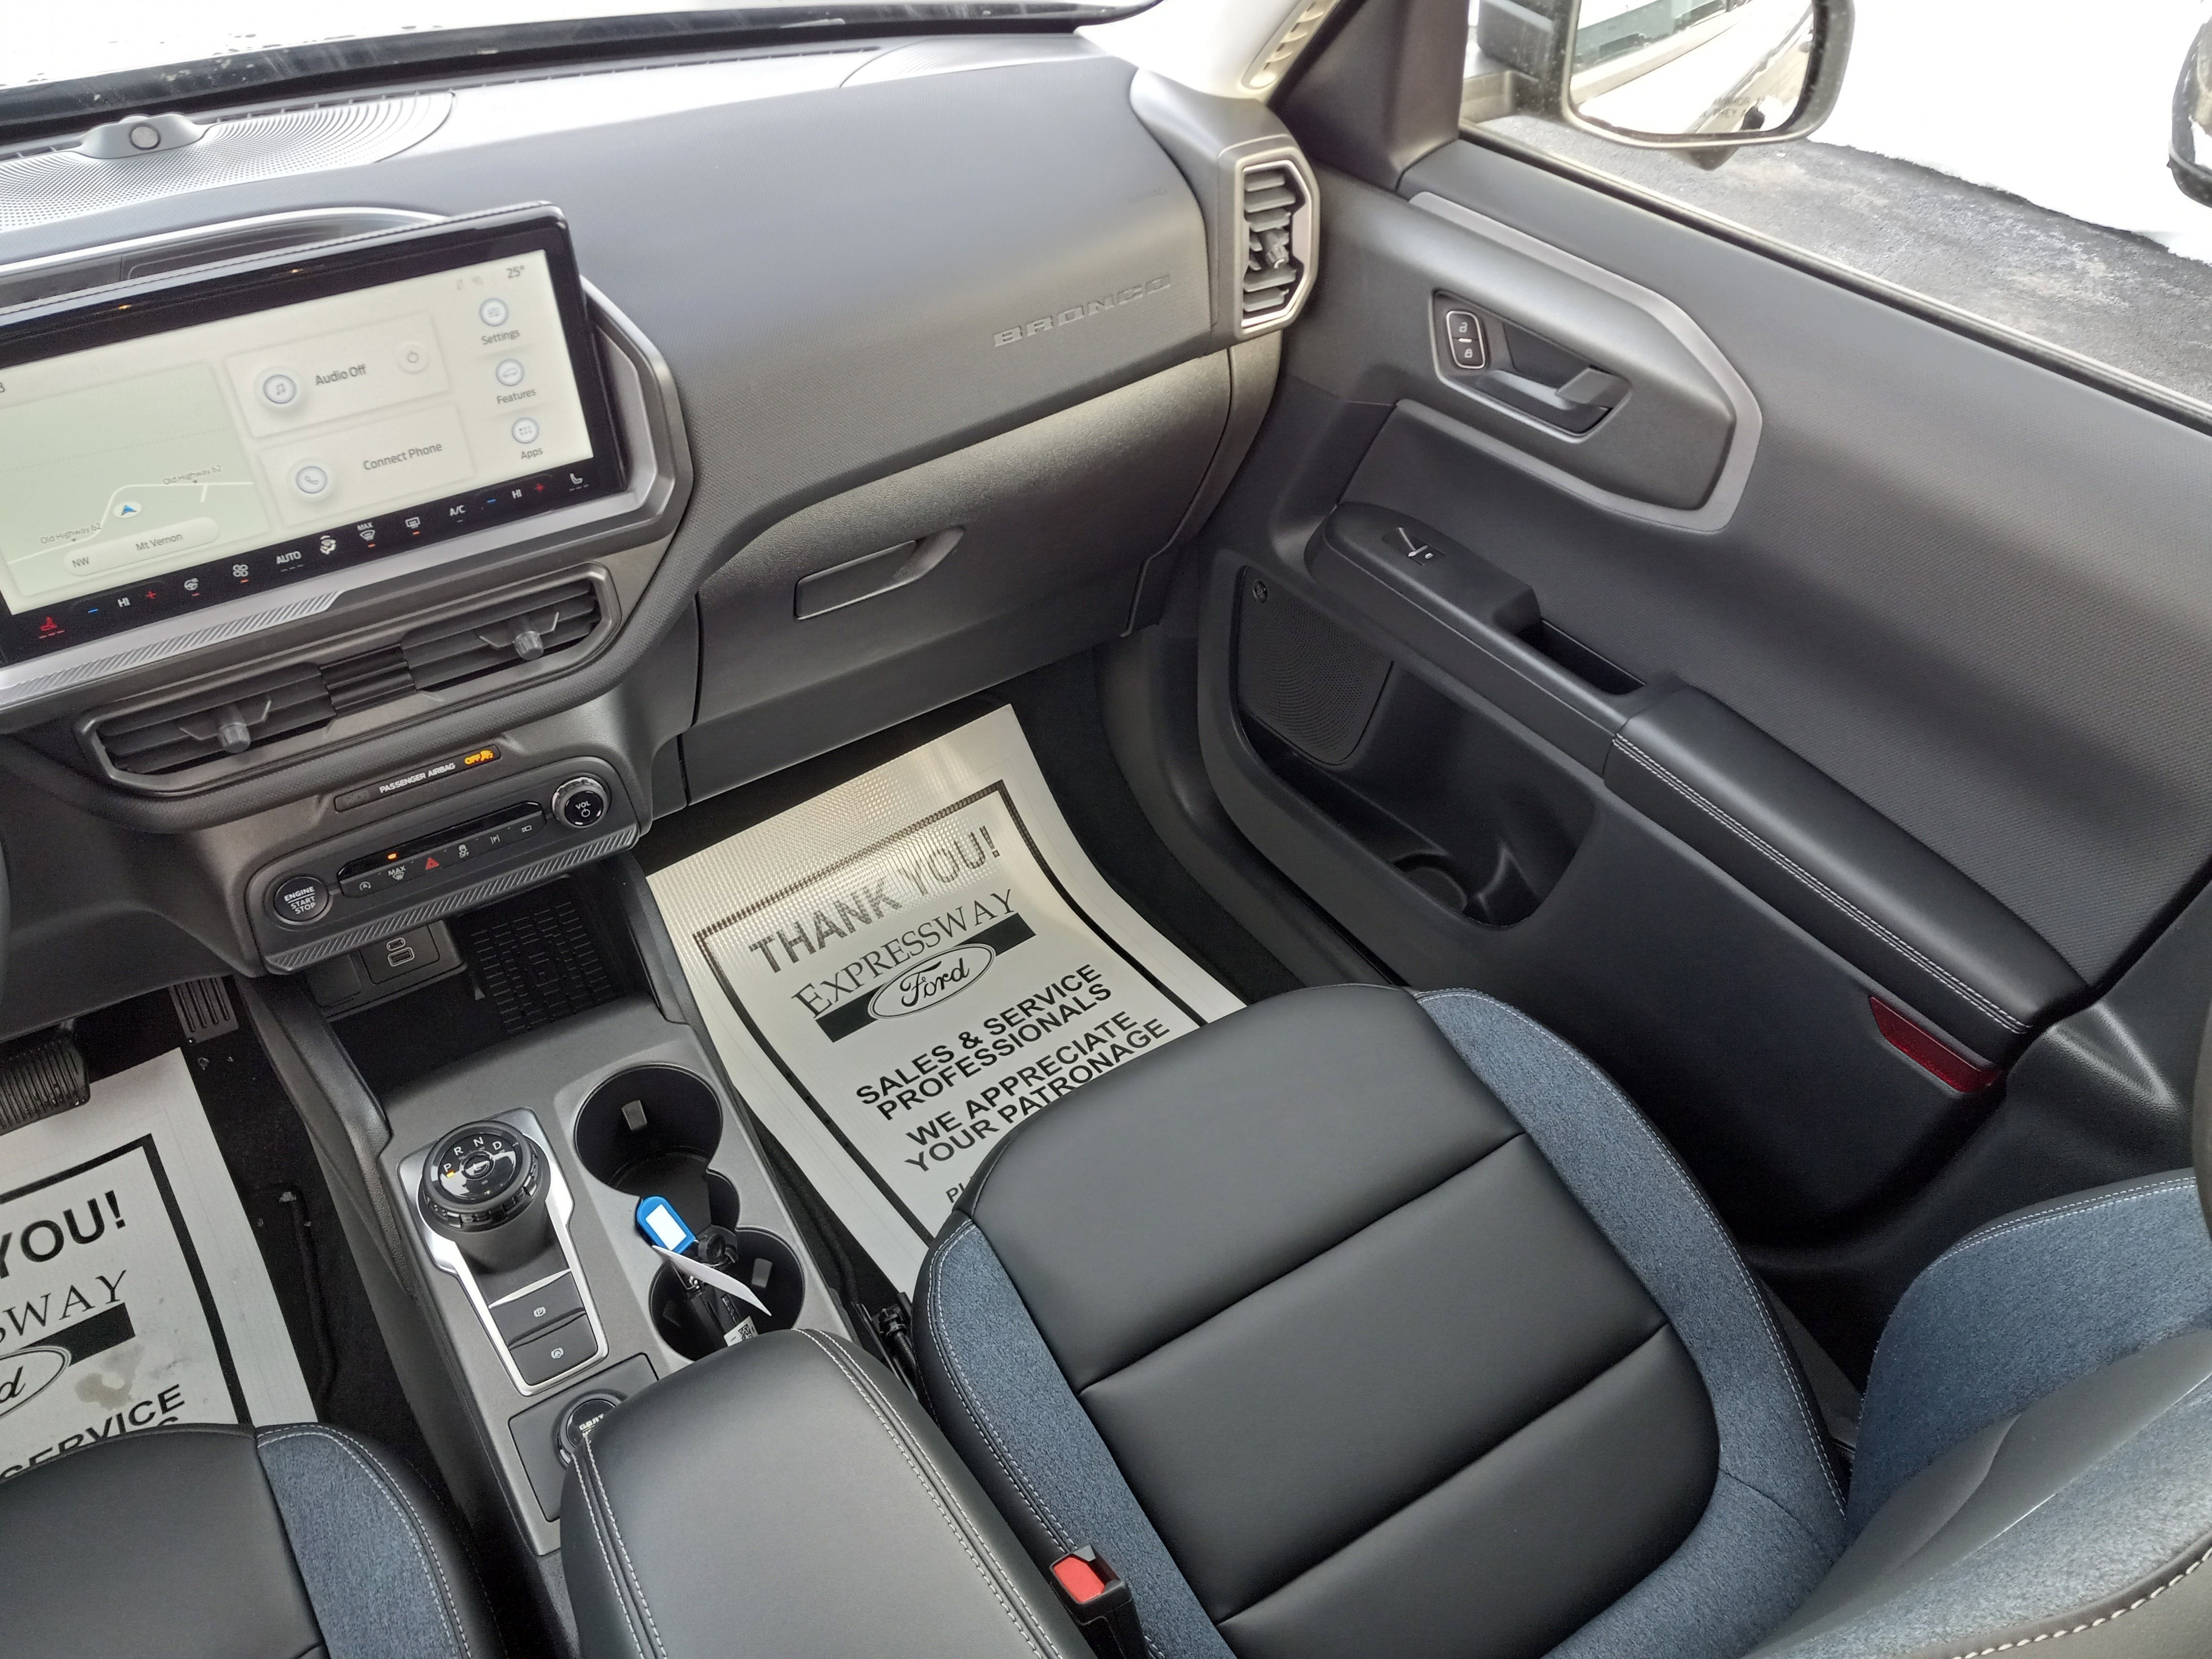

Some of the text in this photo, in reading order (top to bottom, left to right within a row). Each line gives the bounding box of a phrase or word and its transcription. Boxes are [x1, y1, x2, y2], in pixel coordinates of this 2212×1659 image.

[994, 274, 1171, 347] BRONCO
[481, 328, 521, 346] Settings
[315, 364, 367, 385] Audio Off
[496, 387, 537, 405] Features
[363, 442, 443, 470] Connect Phone
[521, 446, 543, 461] Apps
[511, 489, 522, 499] HI
[449, 505, 466, 517] A/C
[41, 522, 101, 545] Old Highway 62
[357, 522, 373, 531] MAX
[136, 533, 182, 551] Mt Vernon
[72, 557, 90, 568] NW
[276, 551, 301, 564] AUTO
[117, 597, 131, 608] HI
[379, 772, 426, 793] PASSENGER
[428, 762, 456, 778] AIRBAG
[575, 801, 591, 809] VOL
[388, 866, 406, 877] MAX
[284, 886, 315, 902] ENGINE
[749, 825, 1000, 974] THANK YOU!
[291, 896, 315, 909] START
[295, 902, 316, 914] STOP
[791, 889, 1014, 1018] EXPRESSWAY
[899, 958, 970, 1007] Ford
[855, 963, 1103, 1105] SALES & SERVICE
[876, 983, 1112, 1121] PROFESSIONALS
[905, 1010, 1139, 1147] WE APPRECIATE
[904, 1018, 1170, 1173] YOUR PATRONAGE
[473, 1136, 484, 1147] N
[492, 1141, 502, 1150] D
[454, 1146, 464, 1155] R
[443, 1163, 452, 1172] P
